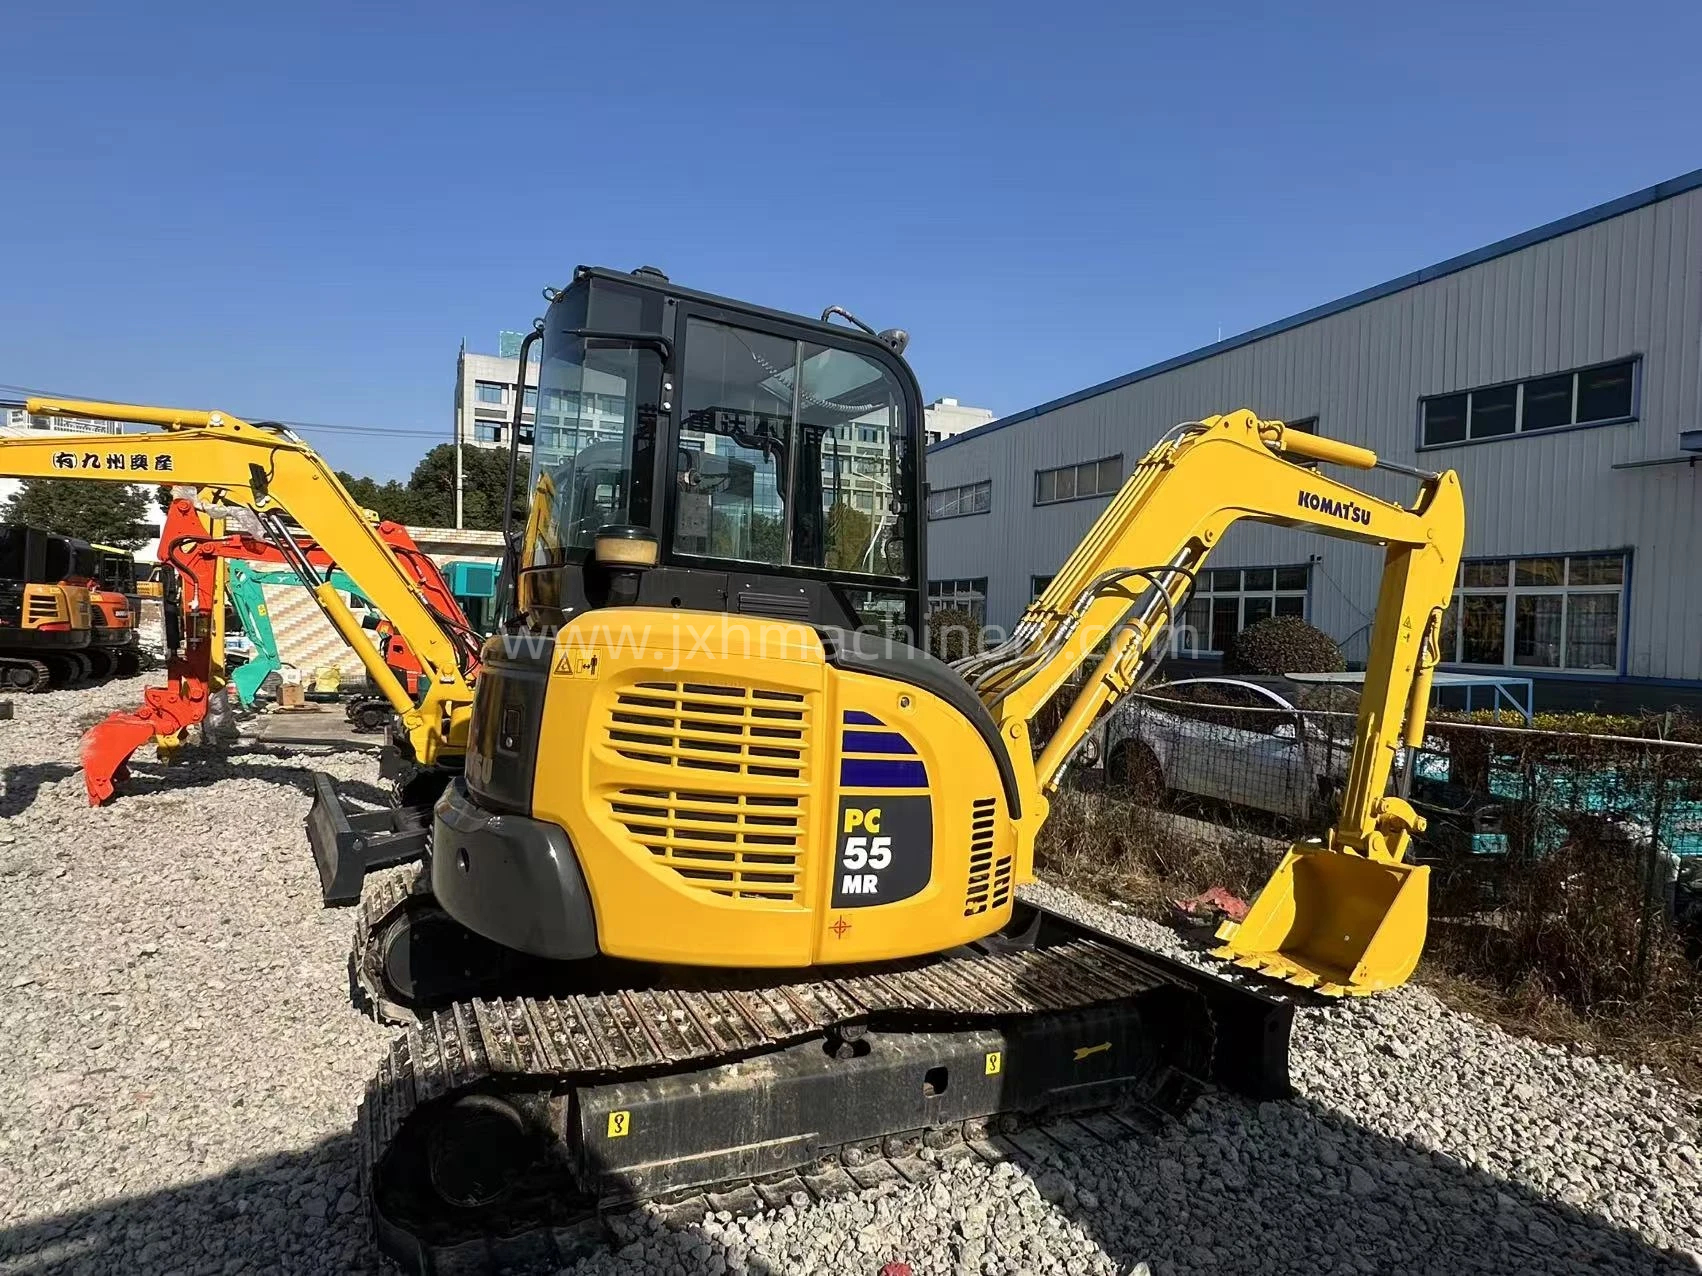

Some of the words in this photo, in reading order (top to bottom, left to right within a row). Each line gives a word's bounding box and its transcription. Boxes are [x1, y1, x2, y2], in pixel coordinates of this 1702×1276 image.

[1297, 490, 1371, 526] KOMATSU
[843, 807, 882, 834] PC
[842, 836, 892, 870] 55
[841, 874, 878, 894] MR
